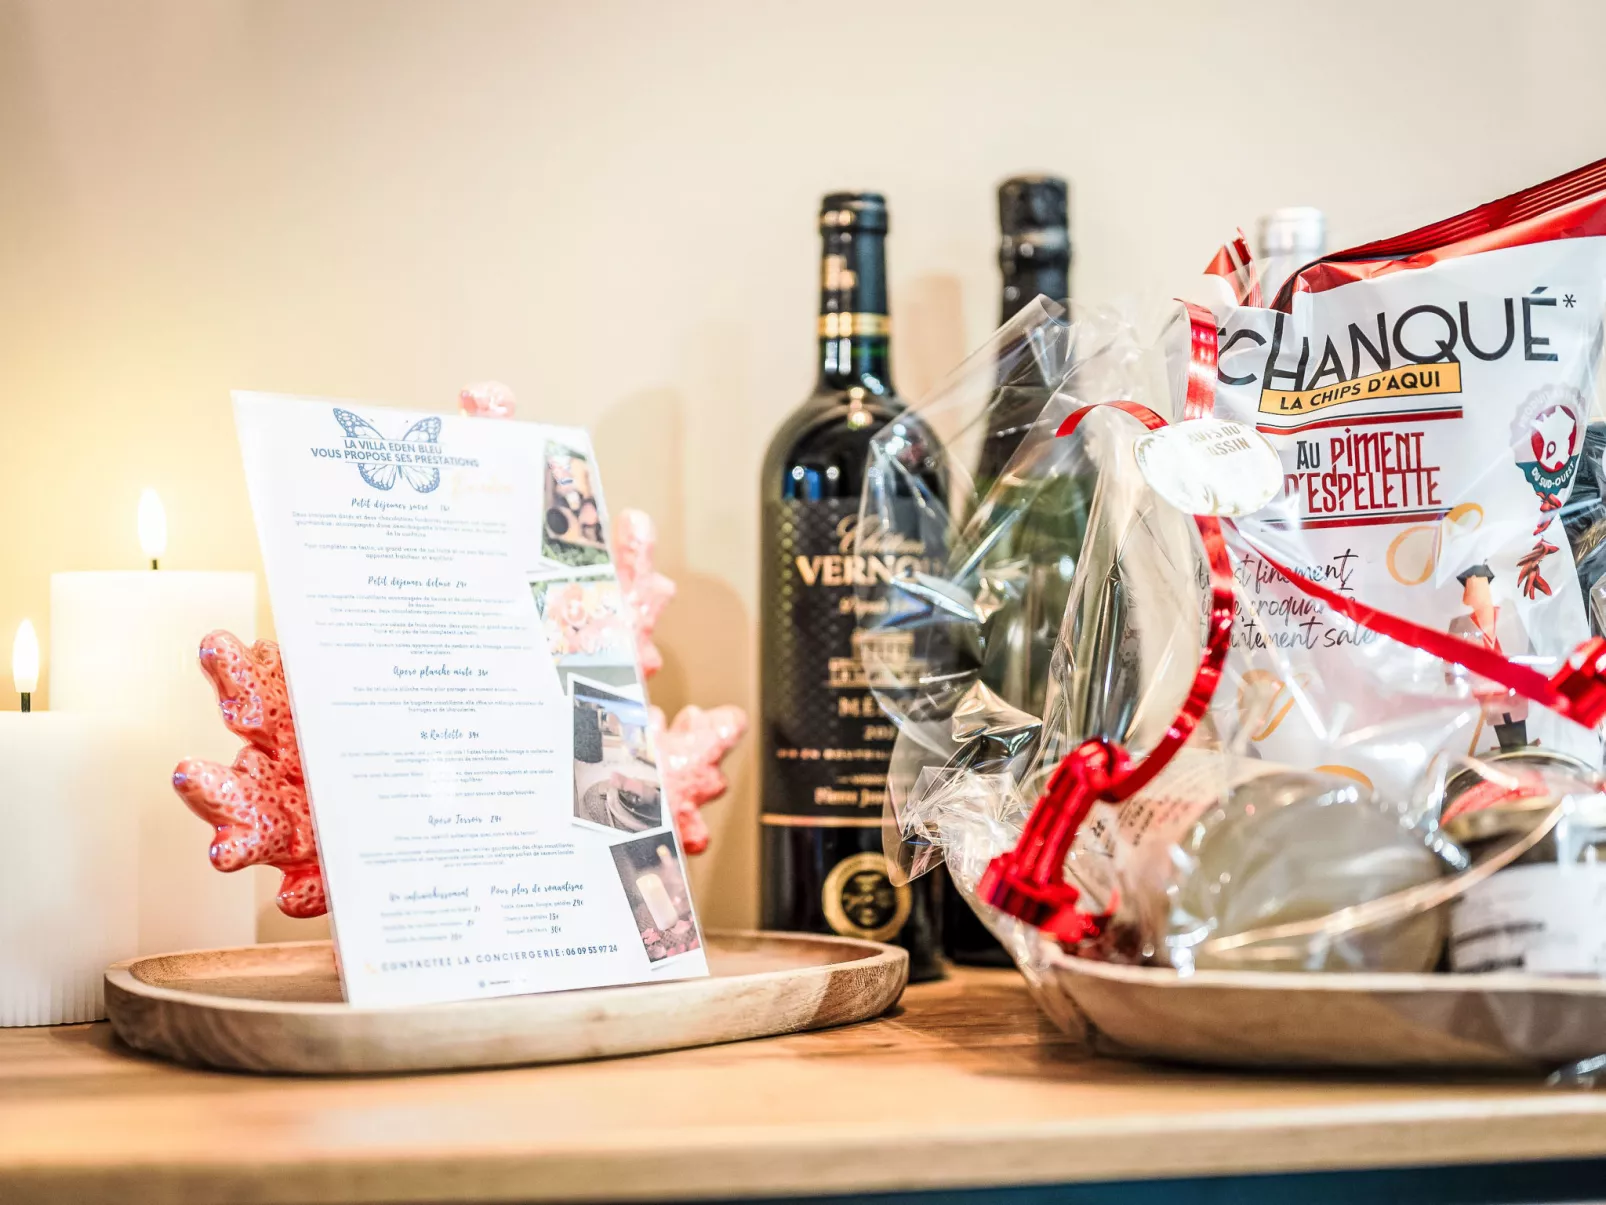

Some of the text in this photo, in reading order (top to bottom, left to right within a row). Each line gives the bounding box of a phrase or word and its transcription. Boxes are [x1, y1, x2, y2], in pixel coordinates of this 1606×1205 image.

[1217, 287, 1576, 390] CHANQUÉ
[1279, 370, 1441, 411] LA CHIPS D'AQUI
[1220, 424, 1241, 437] DU
[344, 439, 443, 455] LA VILLA EDEN BLEU
[1206, 437, 1251, 457] ASSIN
[1296, 440, 1320, 470] AU
[310, 447, 480, 468] VOUS PROPOSE SES PRESTATIONS
[1531, 461, 1574, 489] DU SUD-OUEST
[350, 497, 371, 509] Petit
[367, 575, 388, 587] Petit
[419, 663, 451, 680] planche
[453, 666, 473, 678] mixte
[455, 813, 482, 826] Terroir
[511, 882, 530, 898] plus
[531, 882, 542, 894] de
[457, 957, 470, 966] LA
[566, 949, 576, 957] 06
[577, 947, 588, 956] 09
[589, 946, 598, 955] 53
[599, 945, 608, 954] 97
[609, 944, 619, 953] 24
